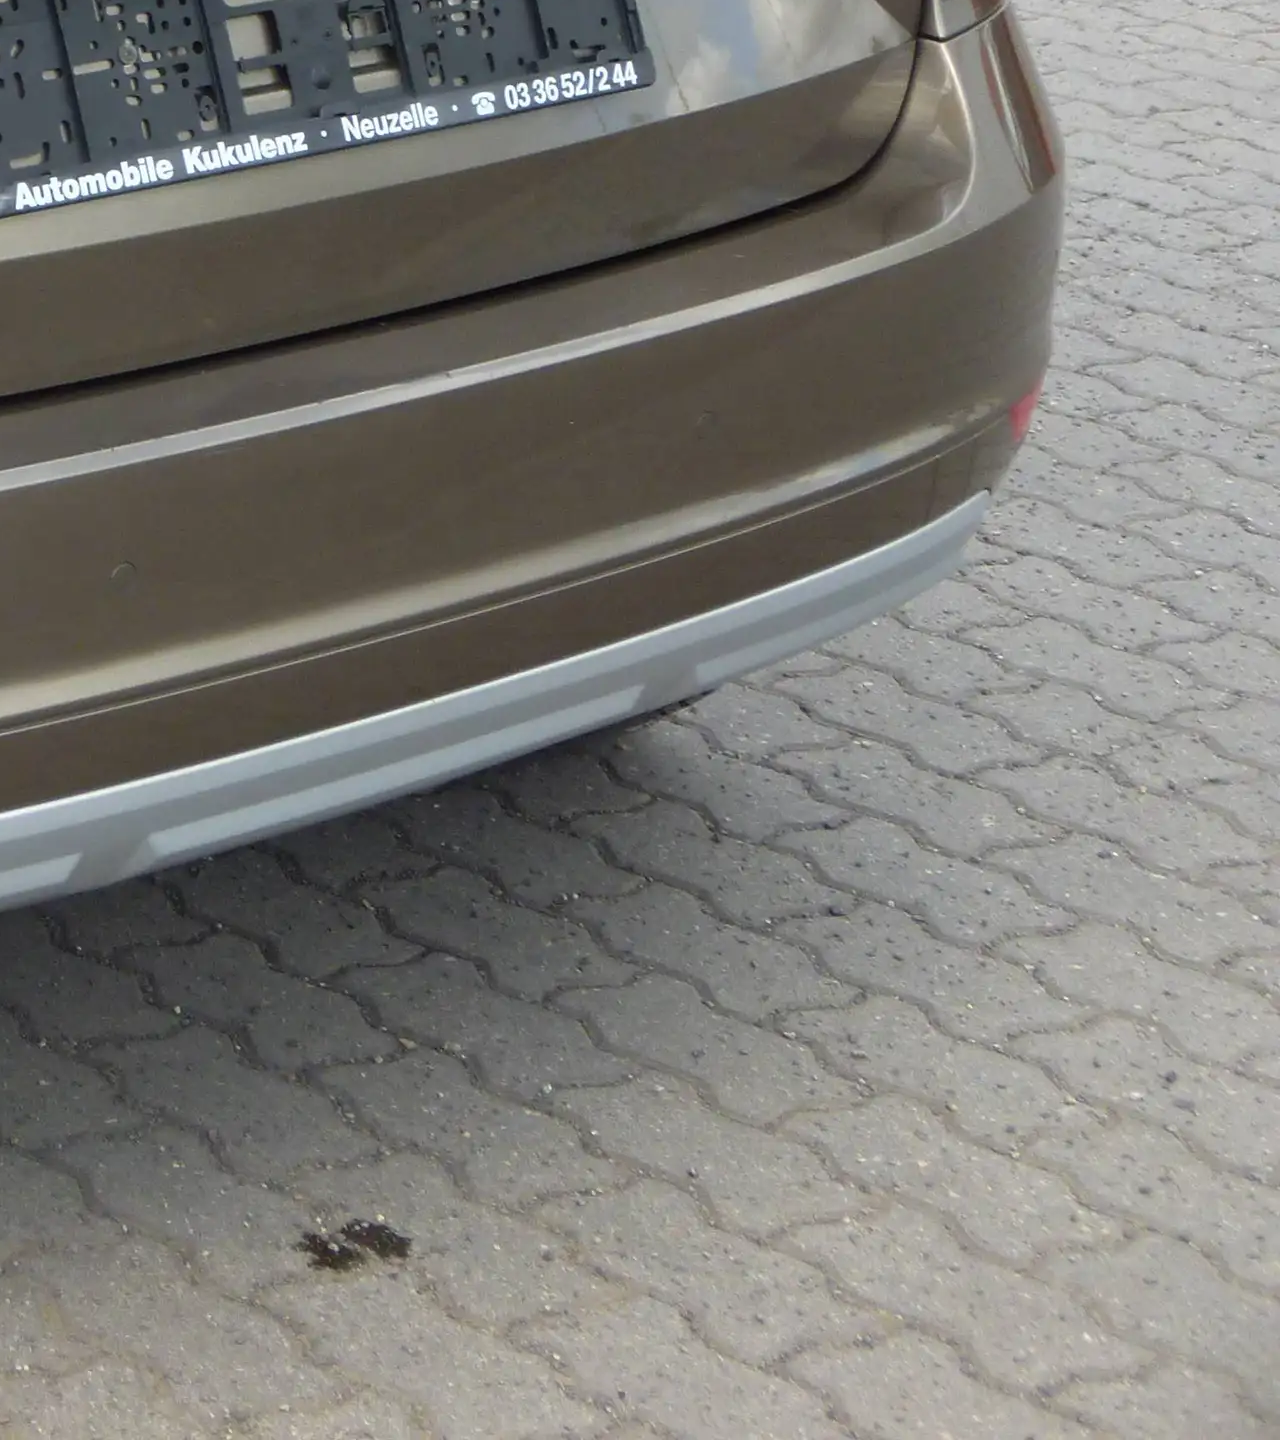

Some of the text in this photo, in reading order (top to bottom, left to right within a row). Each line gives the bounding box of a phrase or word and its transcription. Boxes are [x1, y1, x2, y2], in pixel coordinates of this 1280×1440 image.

[14, 155, 175, 211] Automobile
[181, 131, 309, 175] Kukulenz
[340, 101, 440, 143] Neuzelle
